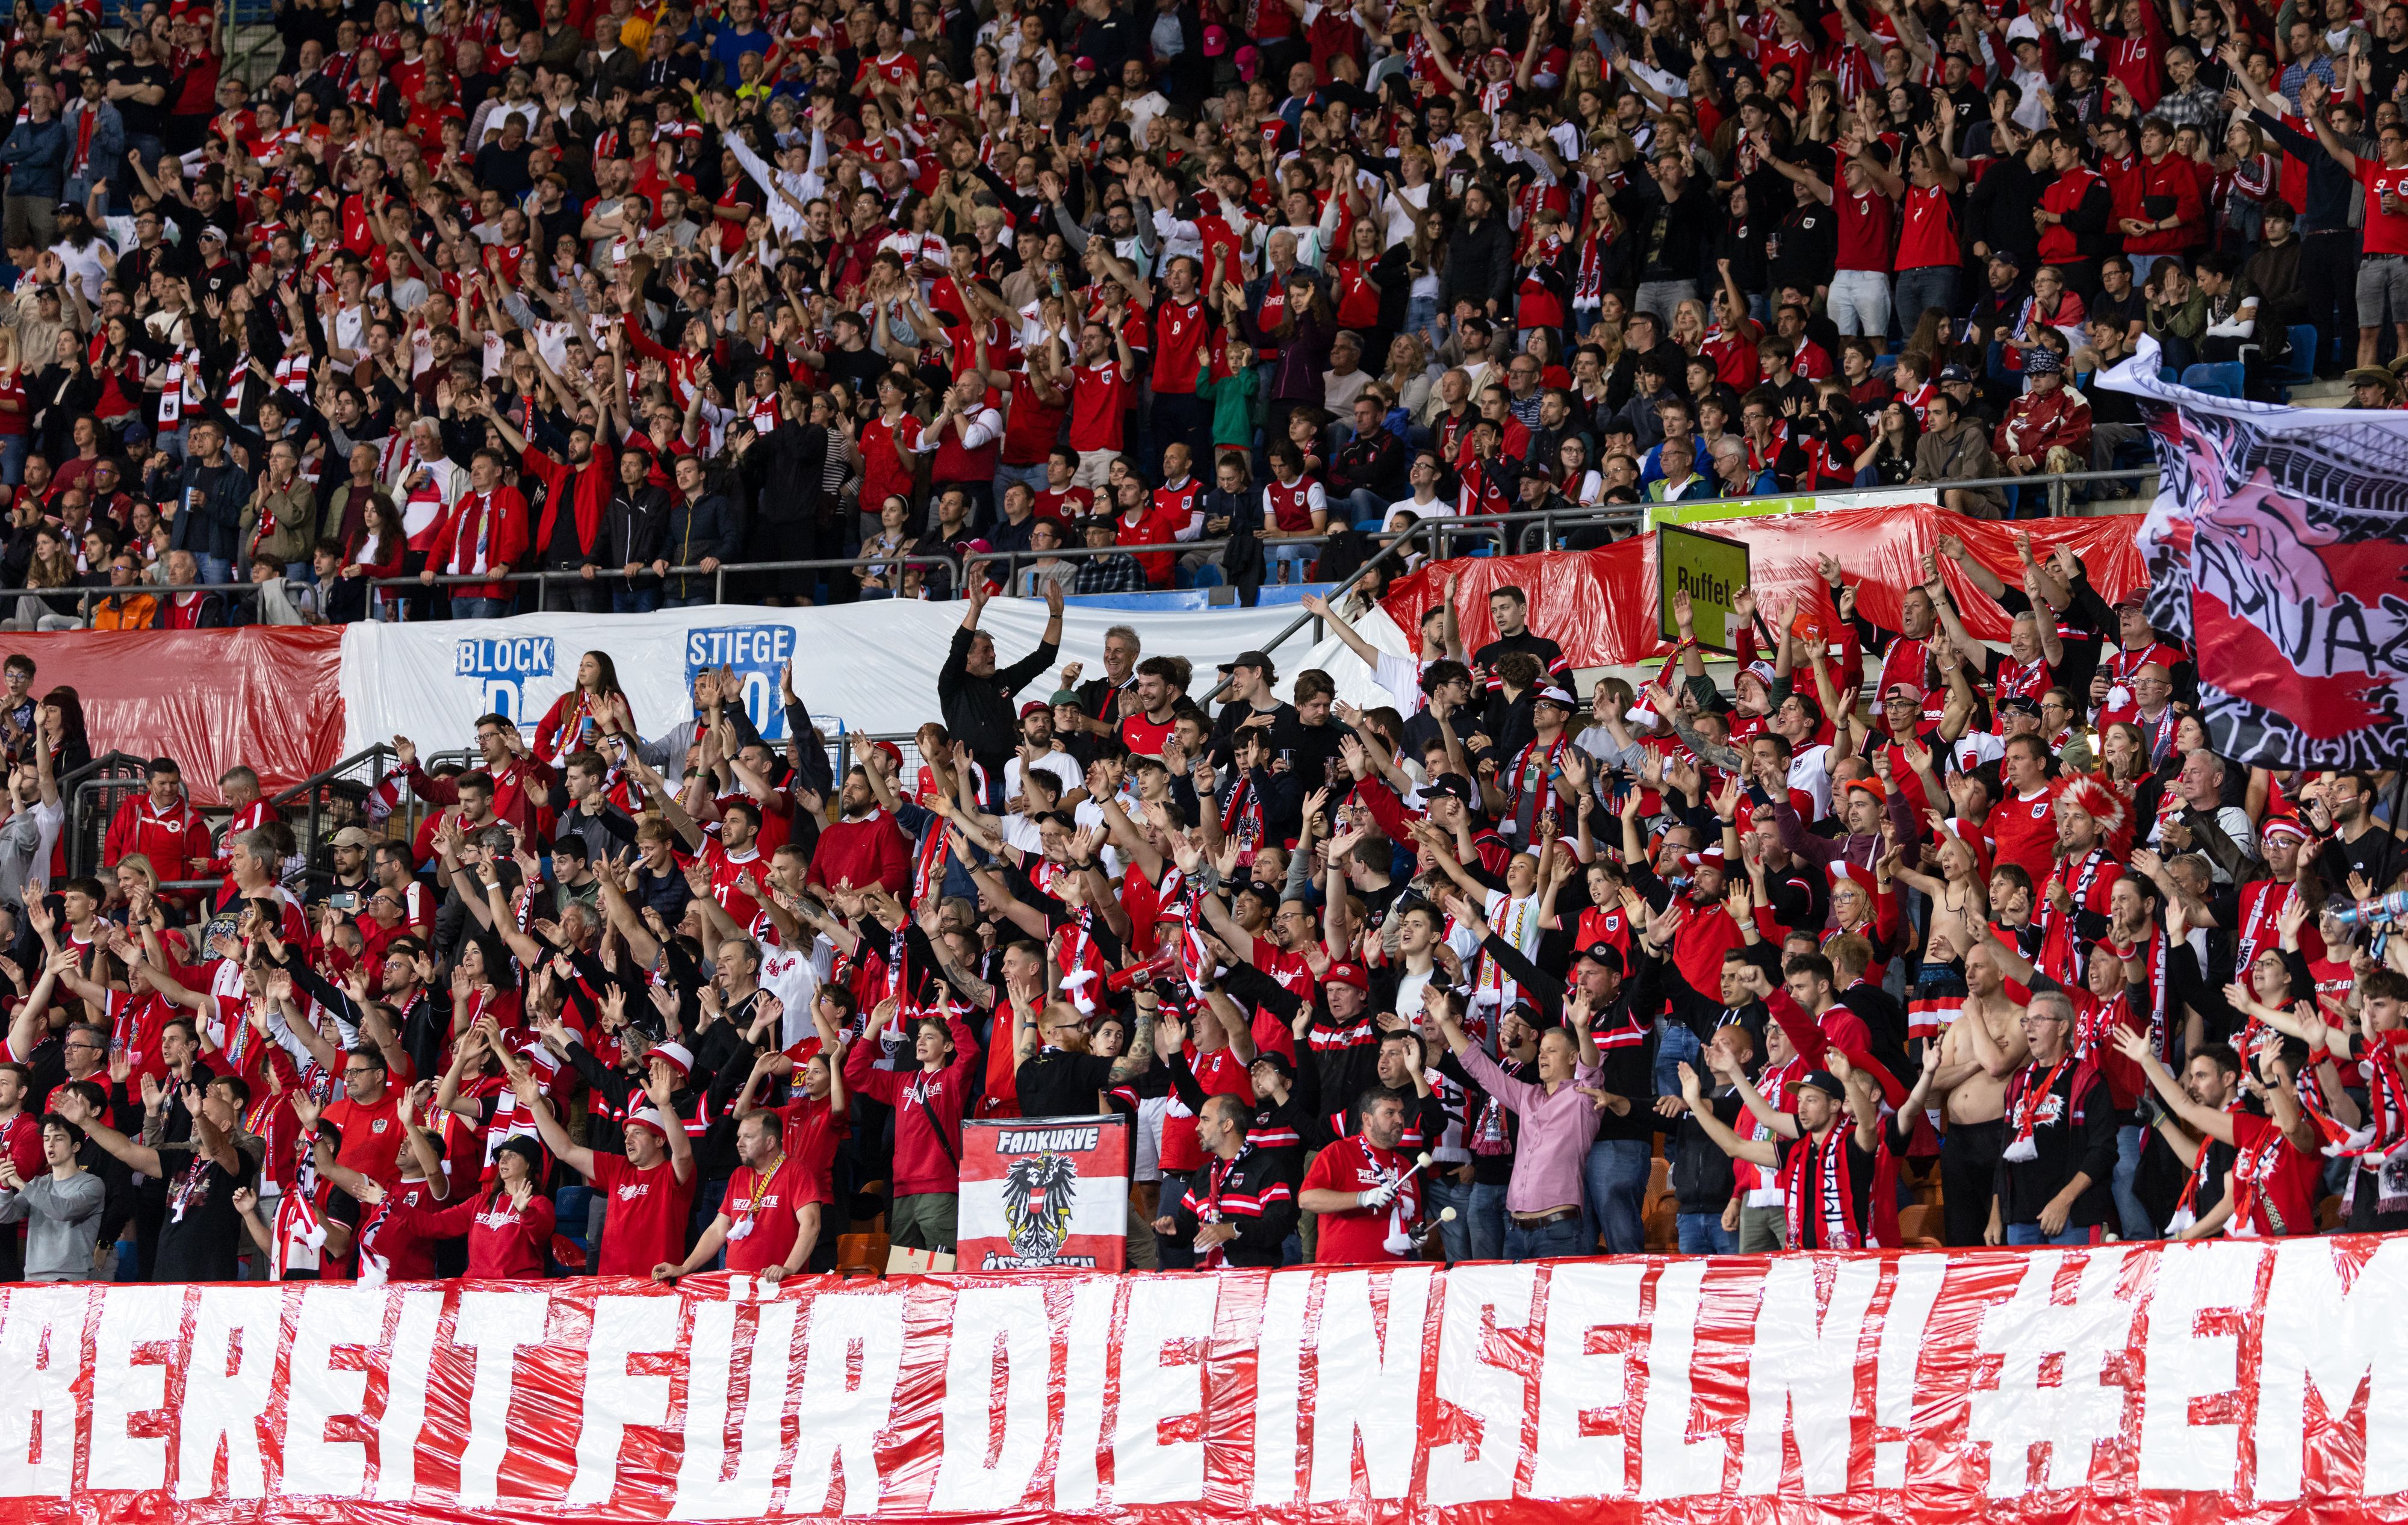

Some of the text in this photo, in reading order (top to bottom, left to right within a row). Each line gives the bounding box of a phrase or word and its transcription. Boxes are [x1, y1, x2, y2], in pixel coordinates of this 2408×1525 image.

[1352, 277, 1360, 293] 7
[1678, 565, 1731, 607] Buffet
[459, 638, 551, 673] BLOCK
[690, 630, 789, 665] STIEGE
[714, 883, 729, 908] 11
[996, 1128, 1100, 1154] FANKURVE
[0, 1281, 550, 1505] BEREIT
[569, 1273, 905, 1519] FÜR
[926, 1273, 1221, 1513] DIE
[1255, 1250, 1949, 1509] INSELN!
